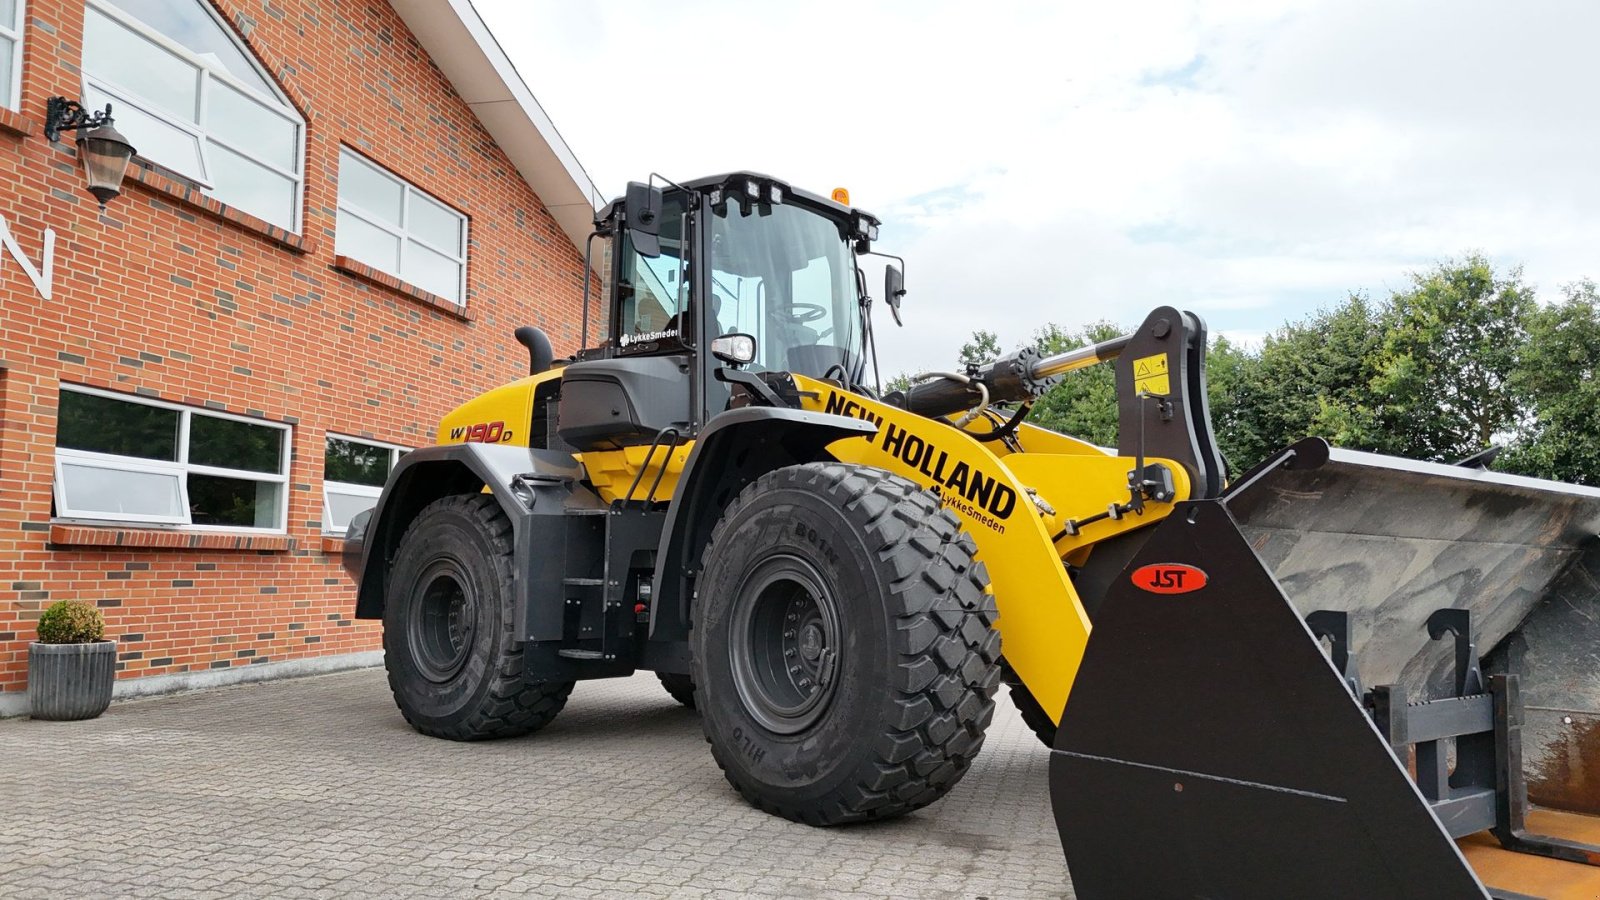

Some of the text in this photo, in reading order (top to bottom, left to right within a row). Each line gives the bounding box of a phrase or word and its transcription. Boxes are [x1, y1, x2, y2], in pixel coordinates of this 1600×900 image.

[881, 422, 1017, 520] HOLLAND
[941, 491, 1006, 535] LykkeSmeden
[1149, 569, 1187, 589] JST
